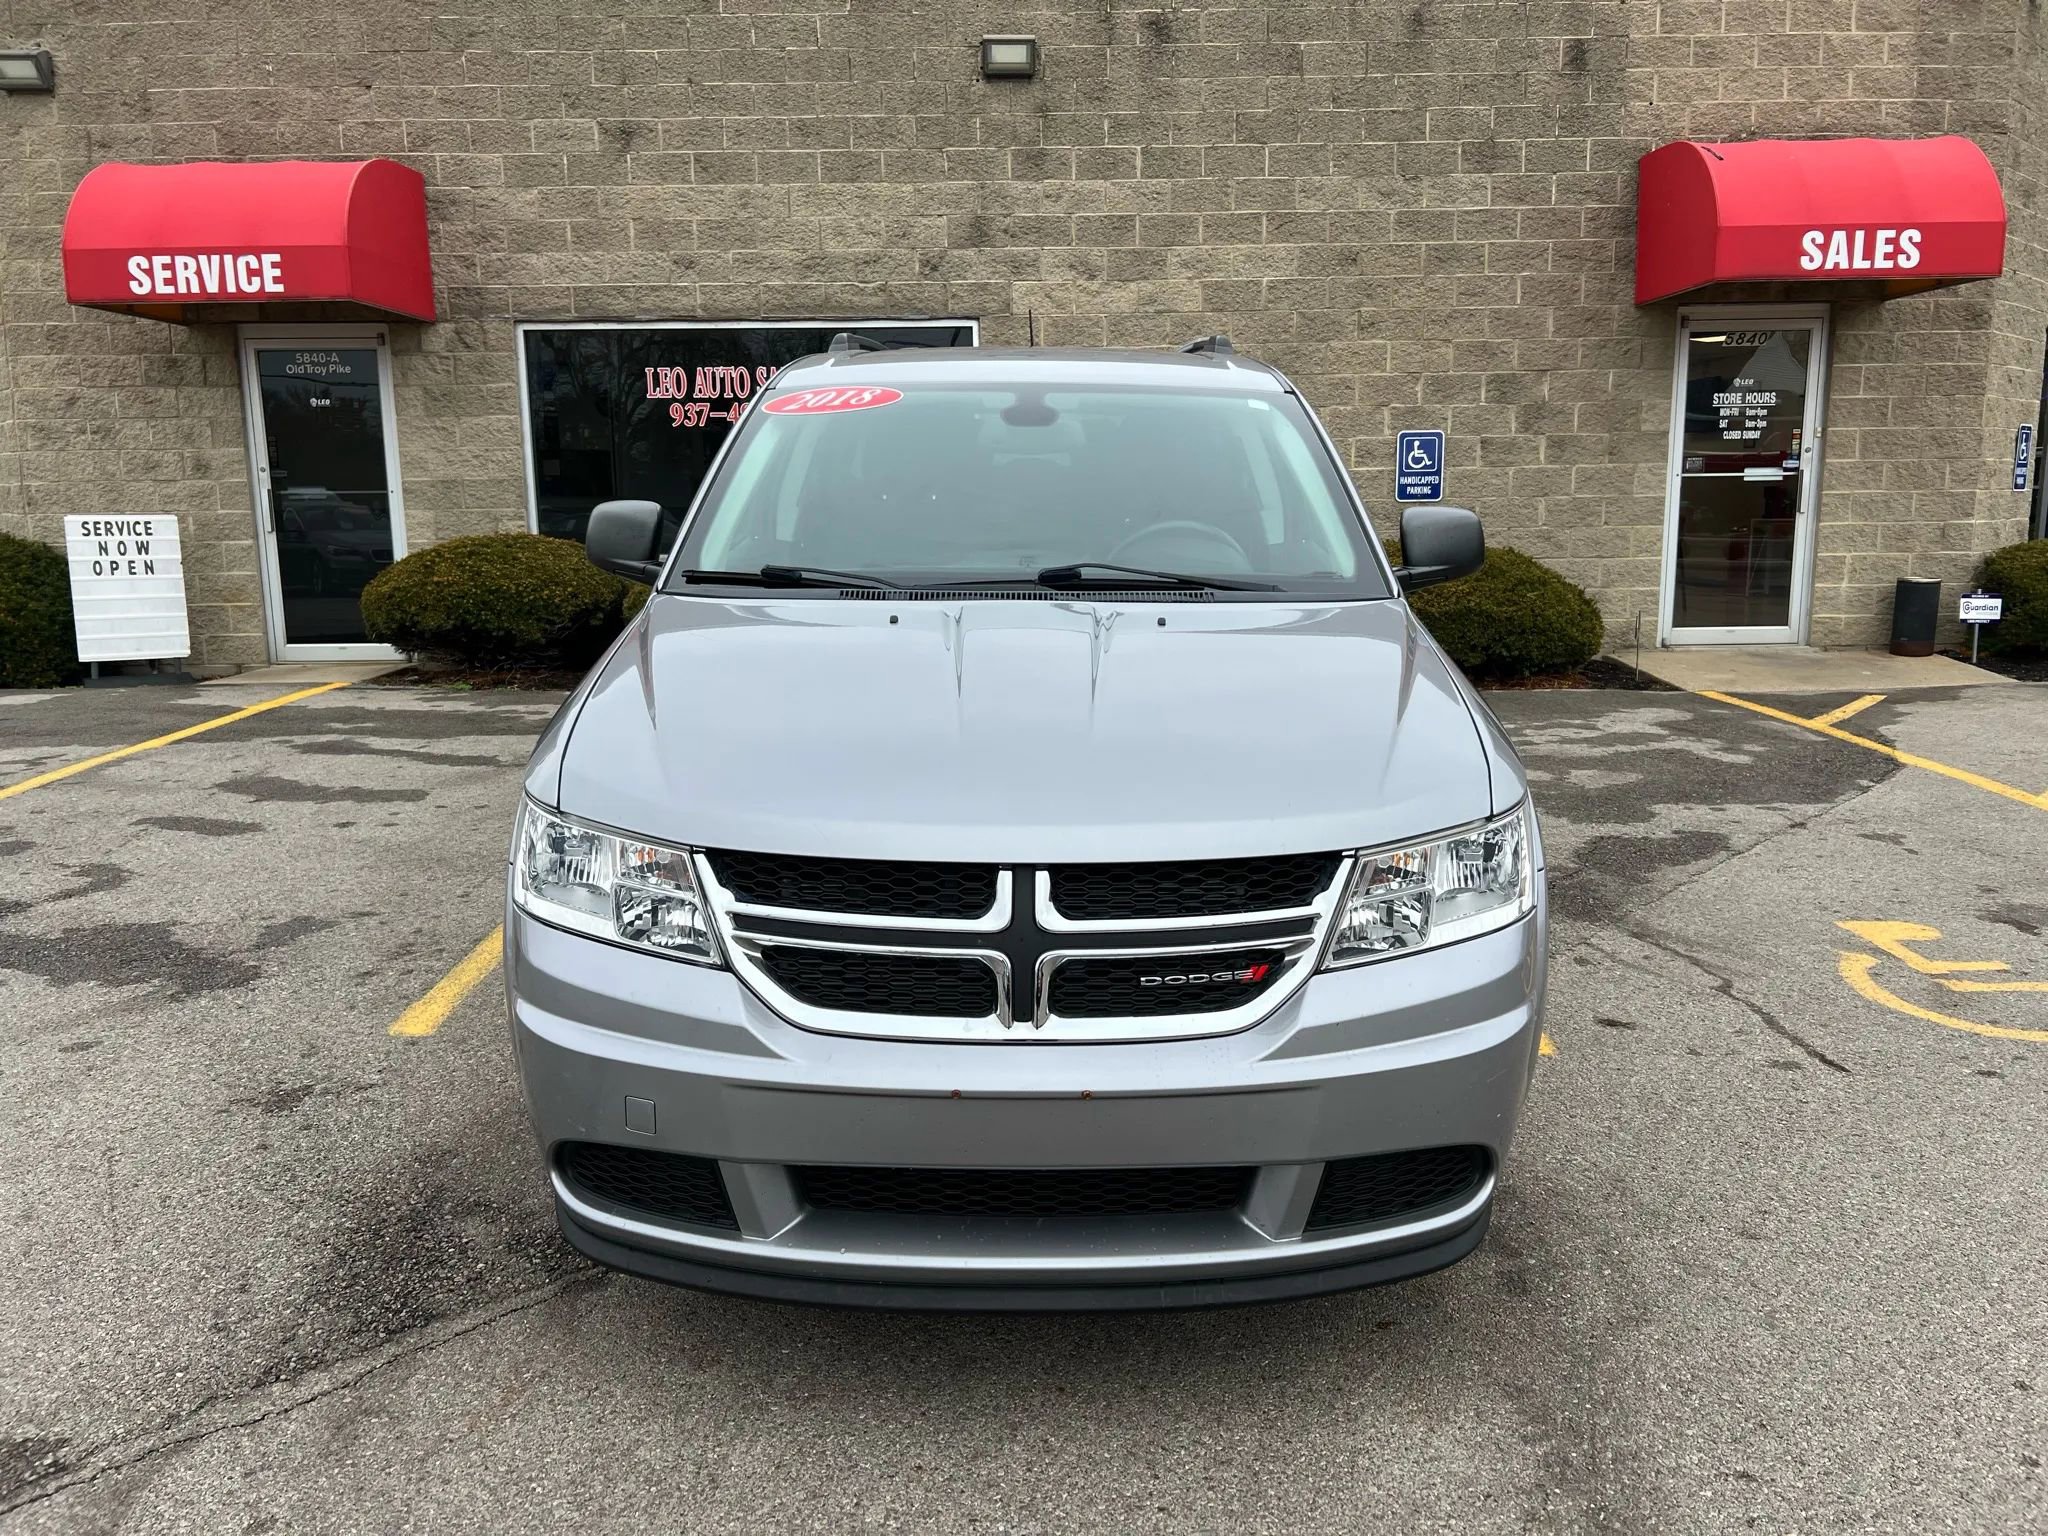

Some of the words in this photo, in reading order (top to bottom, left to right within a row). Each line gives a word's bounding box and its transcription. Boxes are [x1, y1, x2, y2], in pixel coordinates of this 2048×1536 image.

[1800, 229, 1922, 271] SALES
[127, 253, 285, 295] SERVICE
[1725, 332, 1768, 346] 5840
[295, 352, 340, 364] 5840-A
[286, 364, 305, 374] Old
[305, 364, 327, 376] Troy
[329, 364, 352, 374] Pike
[644, 367, 688, 399] LEO
[693, 366, 751, 399] AUTO
[781, 388, 883, 411] 2018
[1712, 392, 1743, 404] STORE
[1745, 391, 1777, 404] HOURS
[1719, 419, 1729, 428] SAT
[1723, 430, 1742, 440] CLOSED
[1742, 430, 1761, 439] SUNDAY
[1399, 475, 1440, 485] HANDICAPPED
[1406, 486, 1432, 495] PARKING
[81, 520, 154, 537] SERVICE
[98, 540, 150, 556] NOW
[92, 560, 155, 576] OPEN
[1963, 602, 1999, 612] Guardian
[1140, 969, 1254, 986] DODGE
